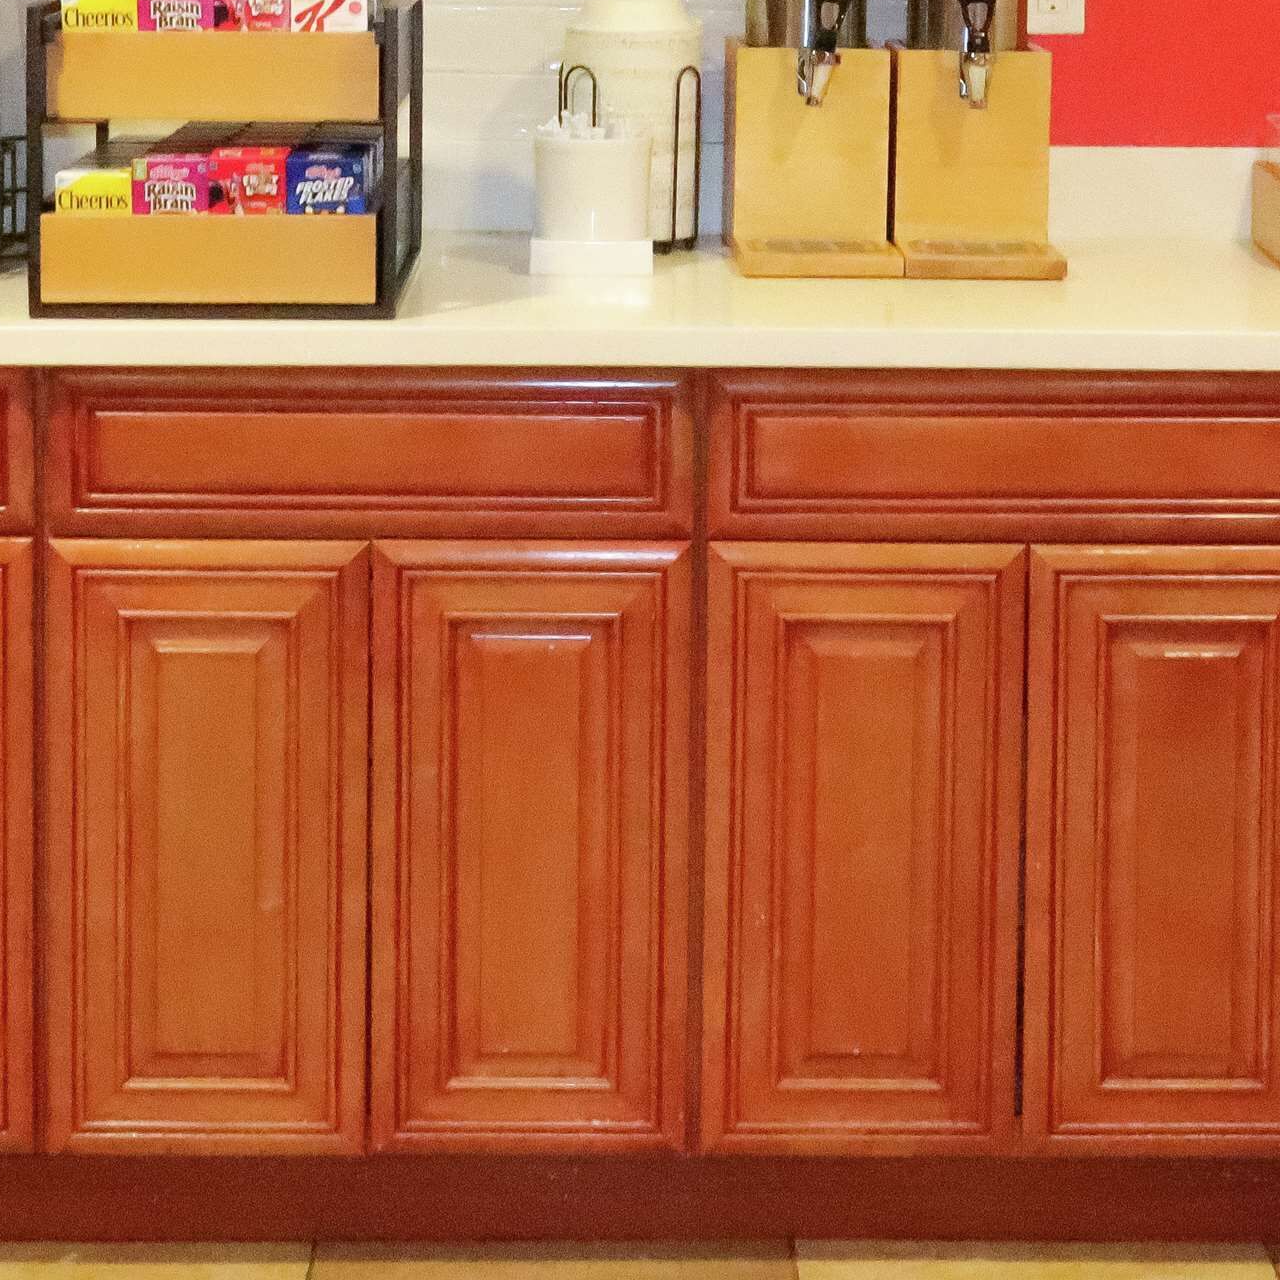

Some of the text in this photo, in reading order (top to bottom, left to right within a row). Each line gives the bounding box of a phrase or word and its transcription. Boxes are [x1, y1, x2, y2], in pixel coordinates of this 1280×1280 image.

[64, 7, 134, 28] Cheerios
[151, 0, 201, 18] Raisin
[157, 14, 196, 31] Bran
[58, 189, 129, 210] Cheerios
[146, 180, 196, 200] Raisin
[151, 196, 192, 212] Bran
